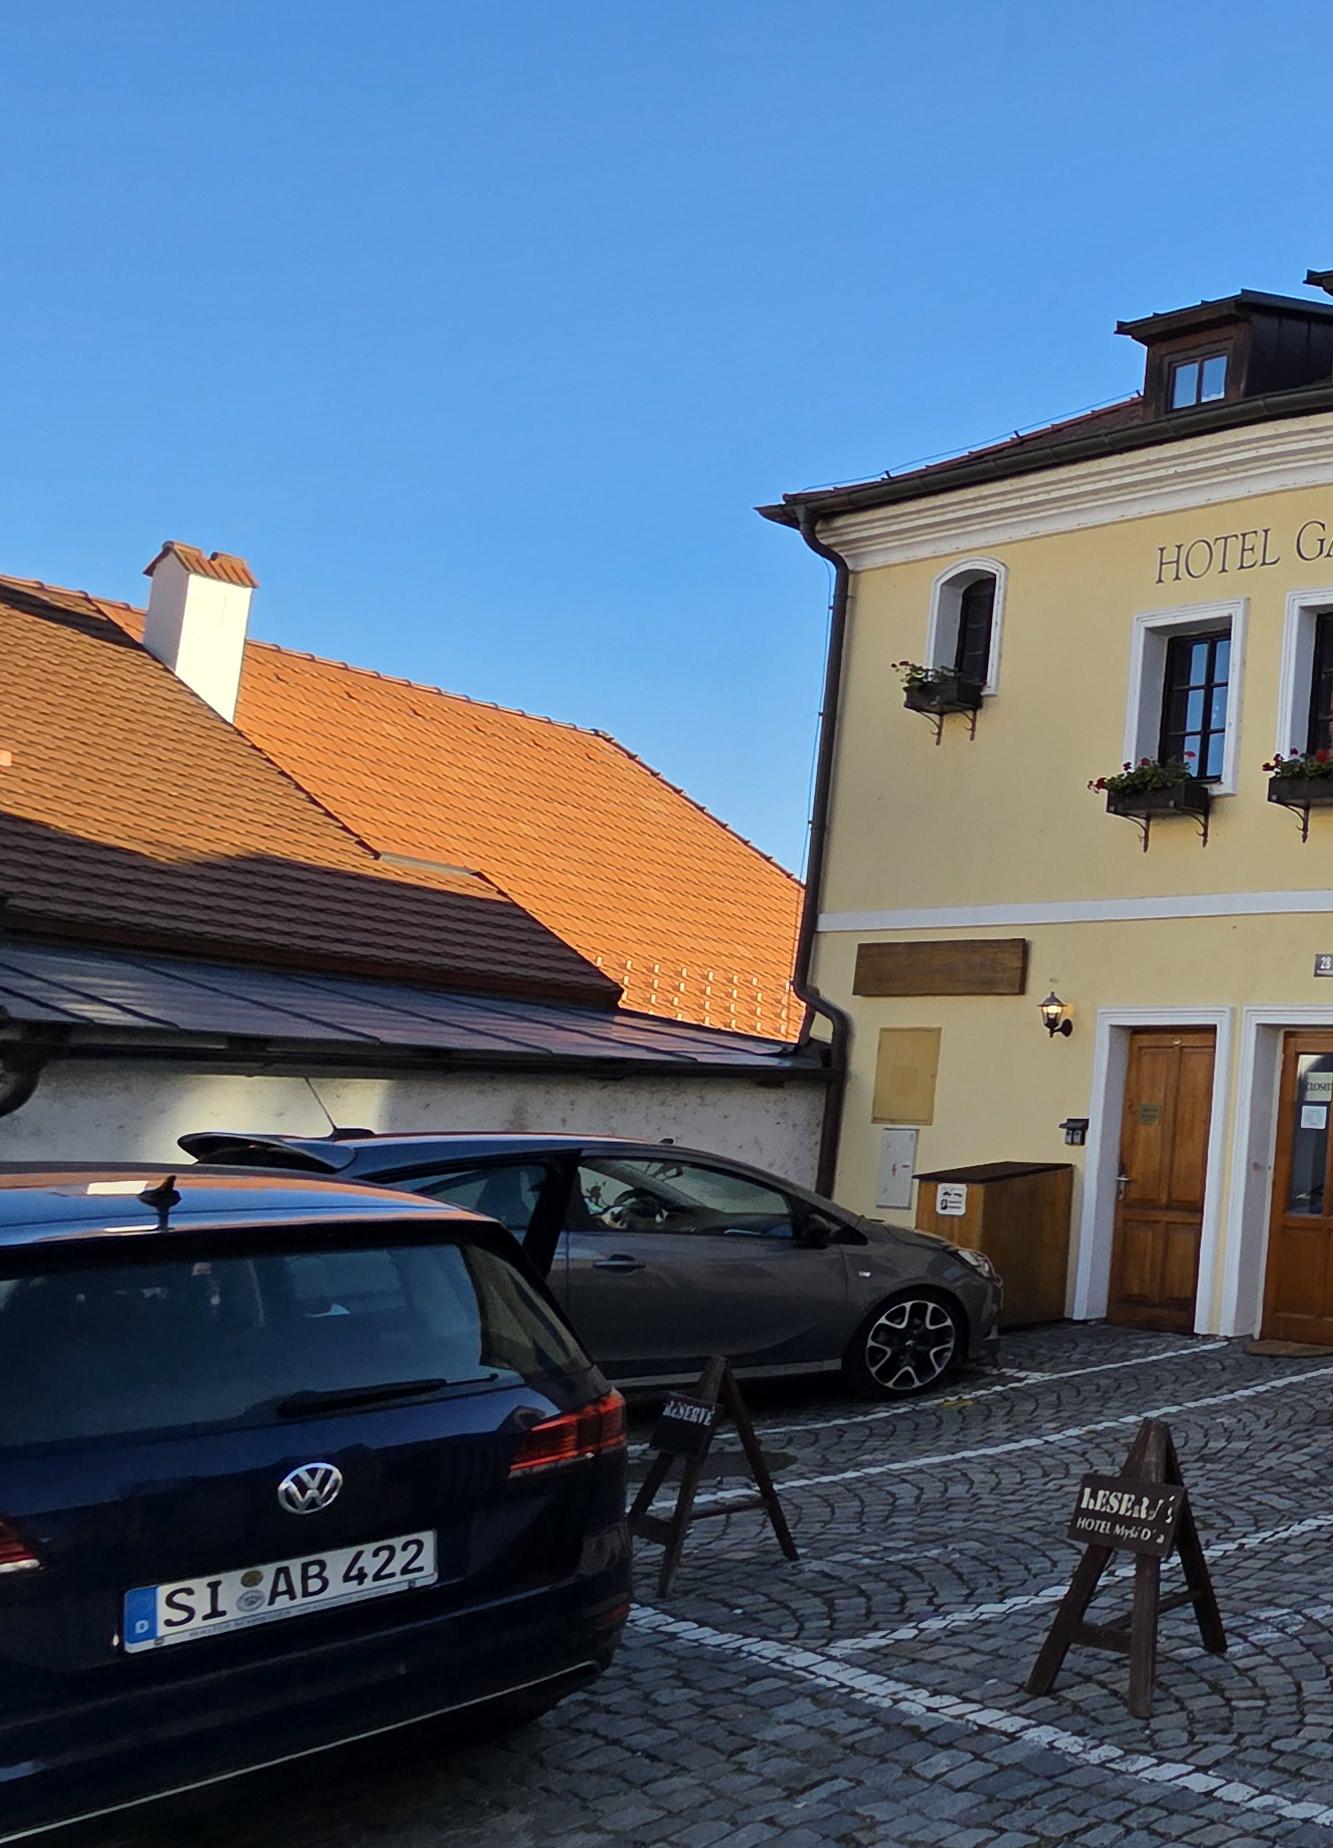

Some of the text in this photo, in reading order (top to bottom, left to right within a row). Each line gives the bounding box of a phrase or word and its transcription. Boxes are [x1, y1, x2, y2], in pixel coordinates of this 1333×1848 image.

[1155, 527, 1281, 585] HOTEL
[1076, 1517, 1112, 1535] HOTEL
[163, 1580, 228, 1628] SI
[267, 1558, 330, 1606] AB
[342, 1538, 425, 1586] 422
[134, 1619, 149, 1634] D
